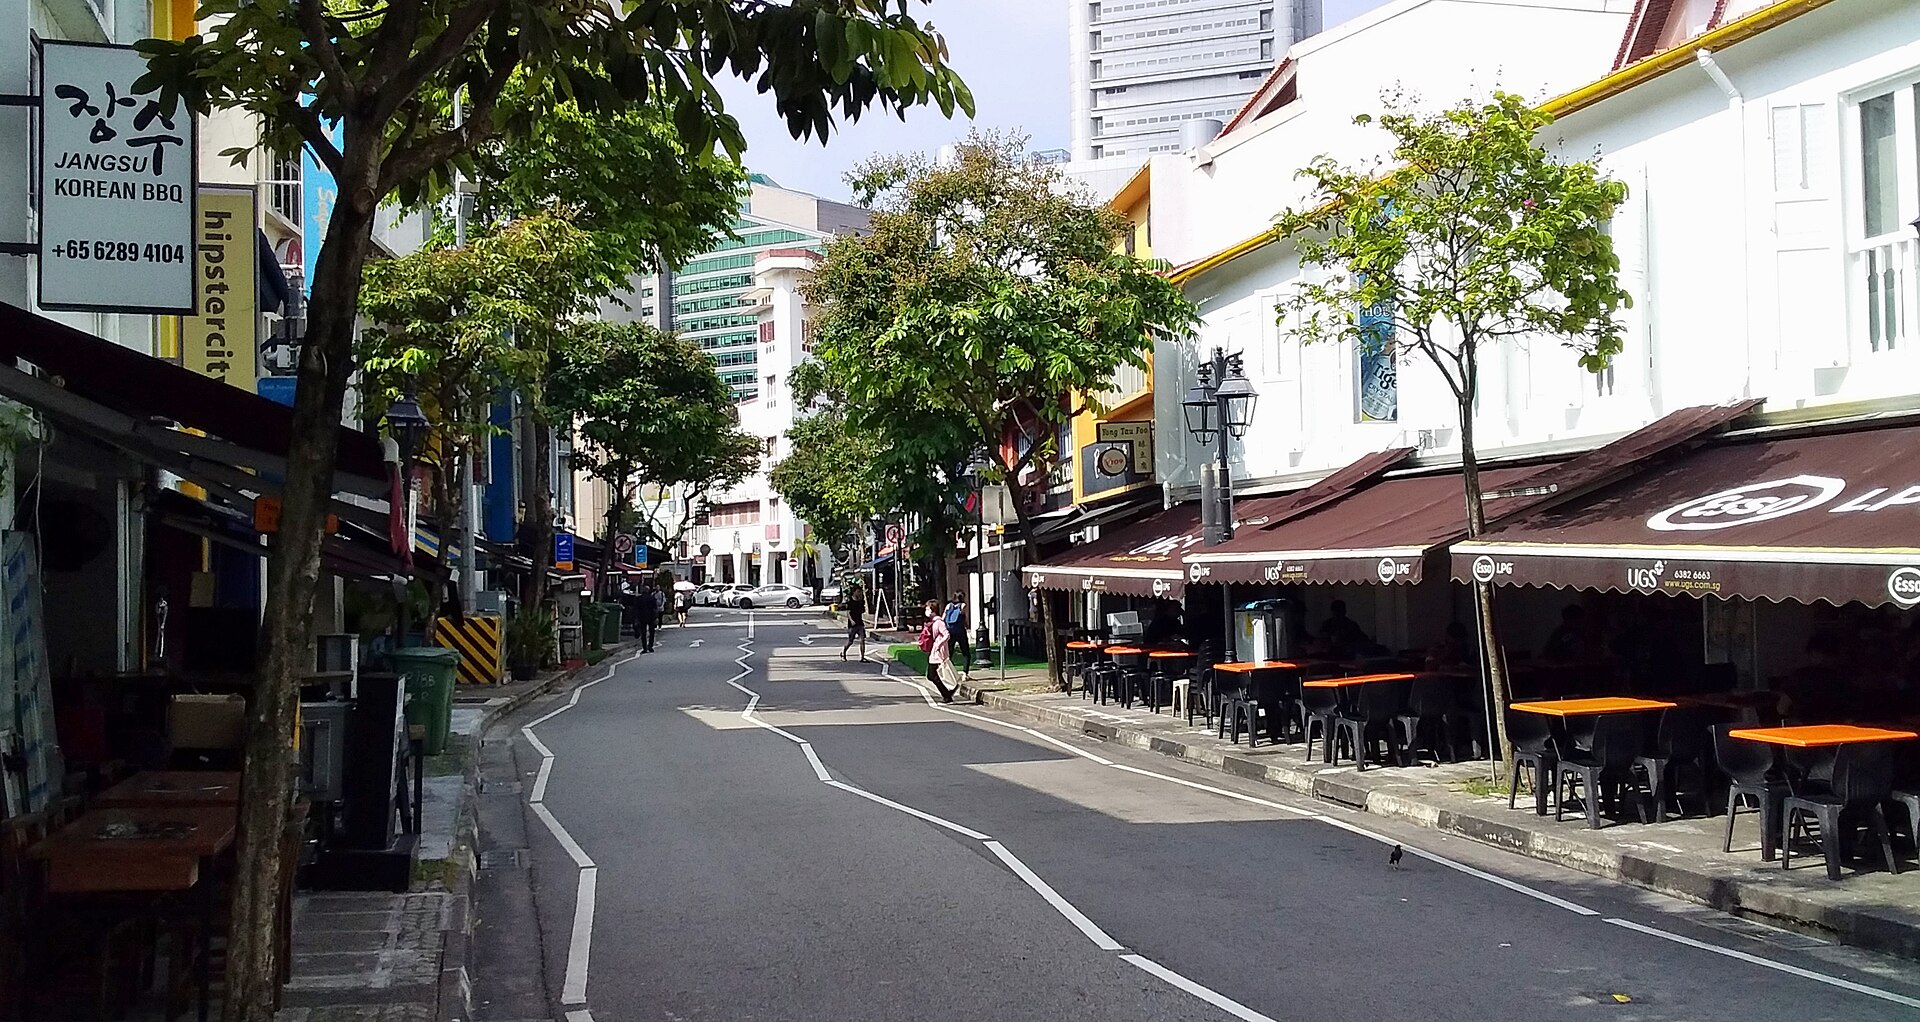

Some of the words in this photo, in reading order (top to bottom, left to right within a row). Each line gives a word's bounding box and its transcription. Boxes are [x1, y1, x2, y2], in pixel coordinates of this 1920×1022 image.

[54, 81, 184, 176] 장수
[54, 152, 148, 173] JANGSU
[54, 178, 136, 200] KOREAN
[142, 183, 184, 204] BBQ
[52, 239, 90, 259] +65
[93, 240, 139, 262] 6289
[143, 243, 185, 264] 4104
[198, 211, 234, 384] hipstercit
[1136, 426, 1148, 435] Foo
[1265, 567, 1280, 580] UGS
[1397, 563, 1411, 575] LPG
[1496, 562, 1514, 575] LPG
[1674, 570, 1691, 579] 6382
[1693, 571, 1711, 580] 6663
[1627, 568, 1657, 588] UGS
[1664, 580, 1721, 591] www.ugs.com.sg
